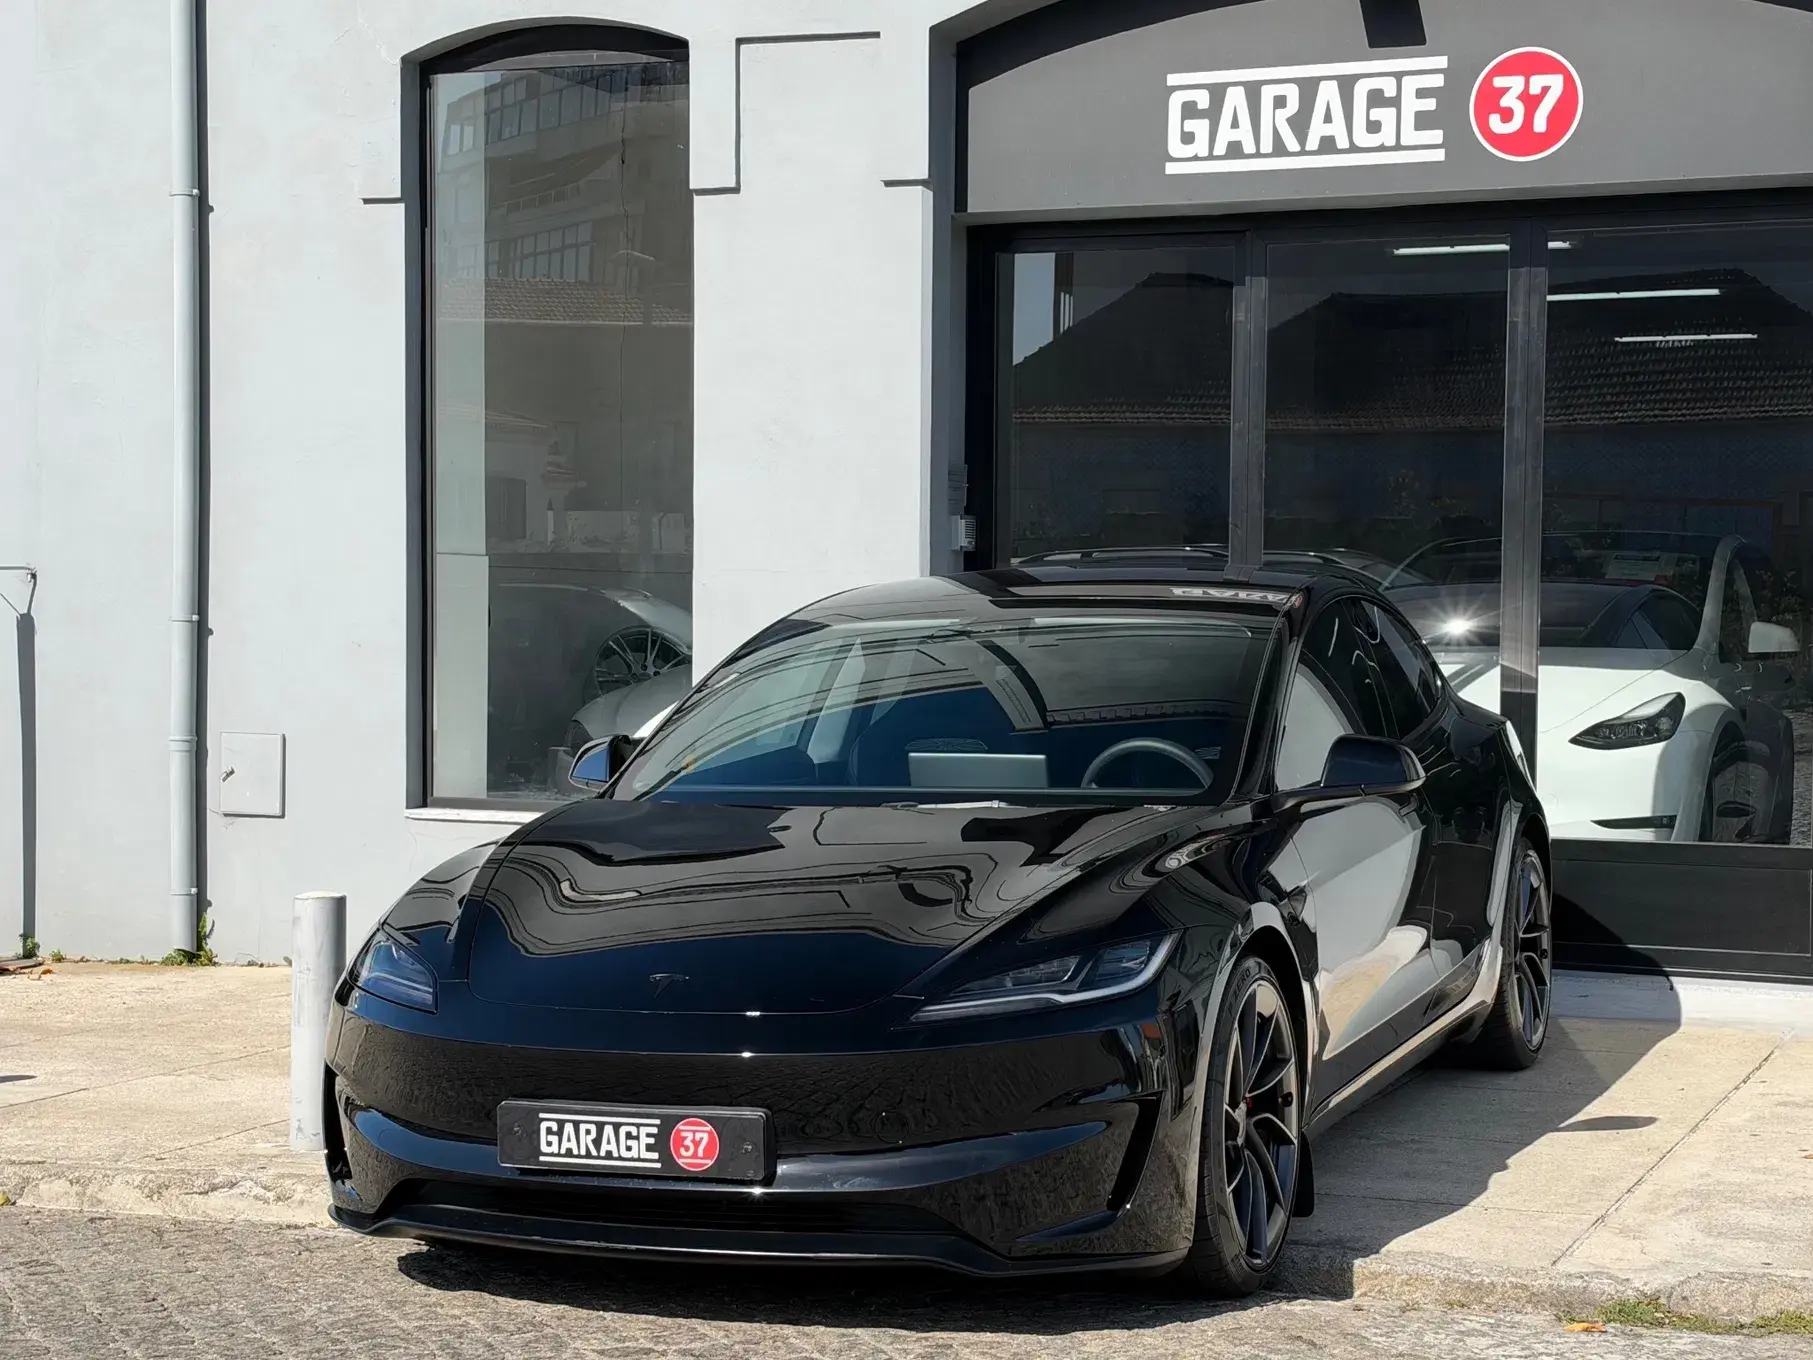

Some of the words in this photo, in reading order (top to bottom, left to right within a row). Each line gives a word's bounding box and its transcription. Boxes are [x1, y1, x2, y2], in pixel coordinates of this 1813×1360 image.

[1167, 73, 1445, 158] GARAGE
[1488, 74, 1564, 134] 37
[1234, 967, 1251, 1000] ZERO
[539, 1121, 660, 1160] GARAGE
[679, 1131, 709, 1158] 37
